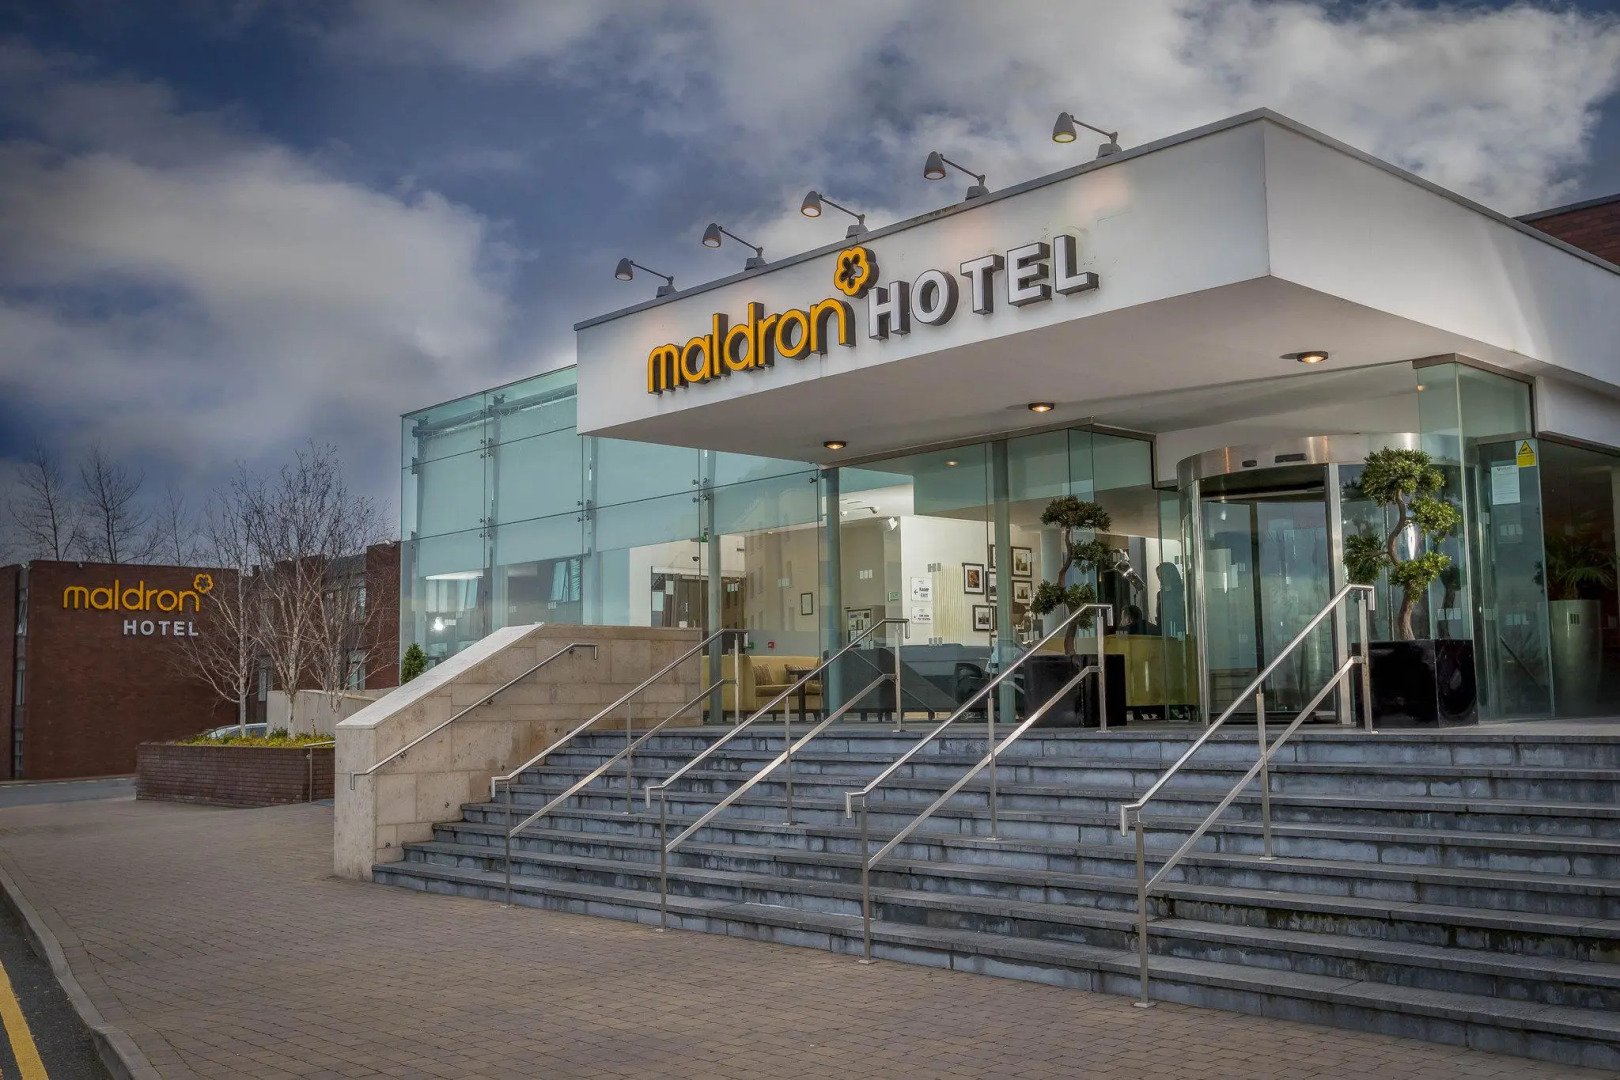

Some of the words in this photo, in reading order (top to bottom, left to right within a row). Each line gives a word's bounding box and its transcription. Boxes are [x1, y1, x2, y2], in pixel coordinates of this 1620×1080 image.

[648, 298, 856, 395] maldron
[868, 235, 1099, 340] HOTEL
[63, 579, 200, 612] maldron
[123, 619, 199, 636] HOTEL
